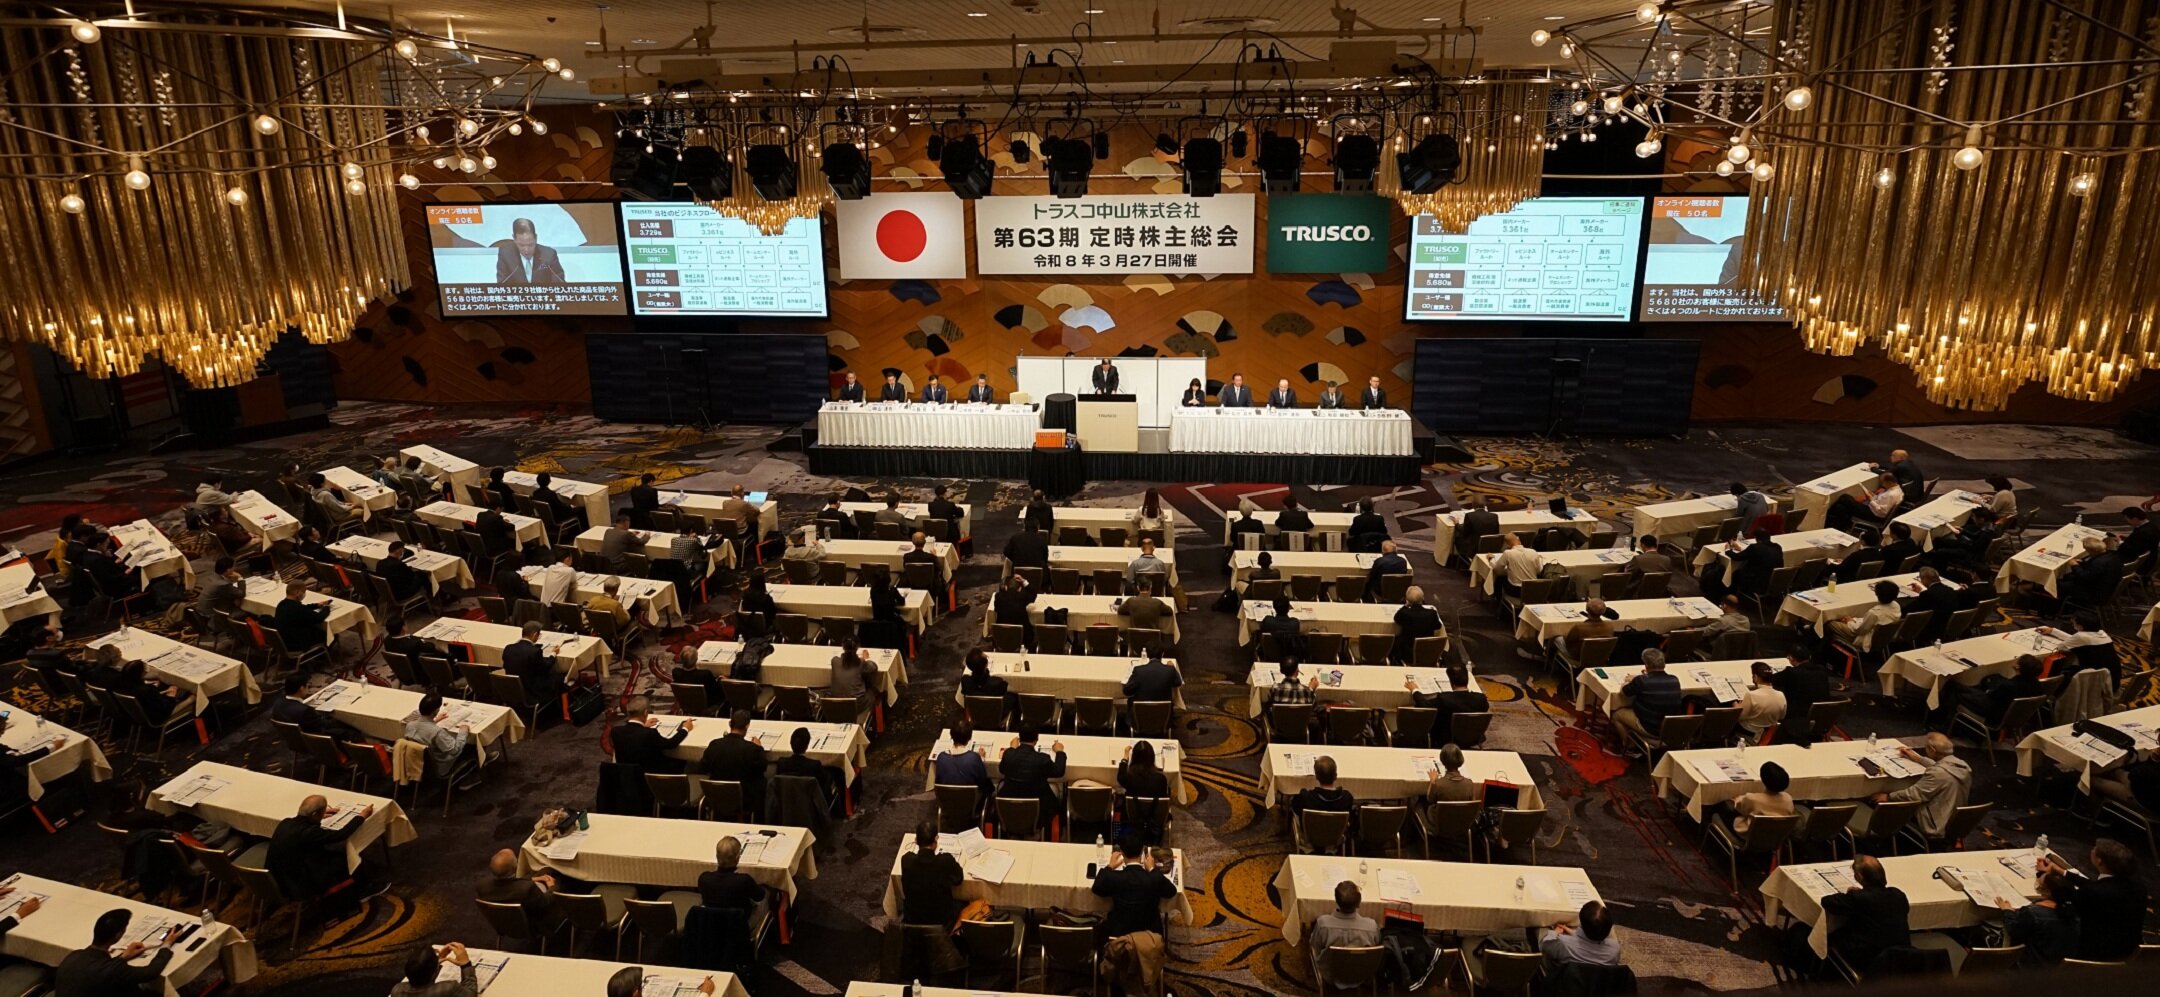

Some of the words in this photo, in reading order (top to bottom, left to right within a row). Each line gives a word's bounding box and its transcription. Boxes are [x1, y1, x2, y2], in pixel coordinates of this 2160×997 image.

[1034, 202, 1200, 220] トラスコ中山株式会社
[994, 226, 1079, 248] 第63期
[1090, 225, 1238, 248] 定時株主総会
[1281, 225, 1371, 242] TRUSCO
[1034, 254, 1198, 268] 令和8年3月27日開催
